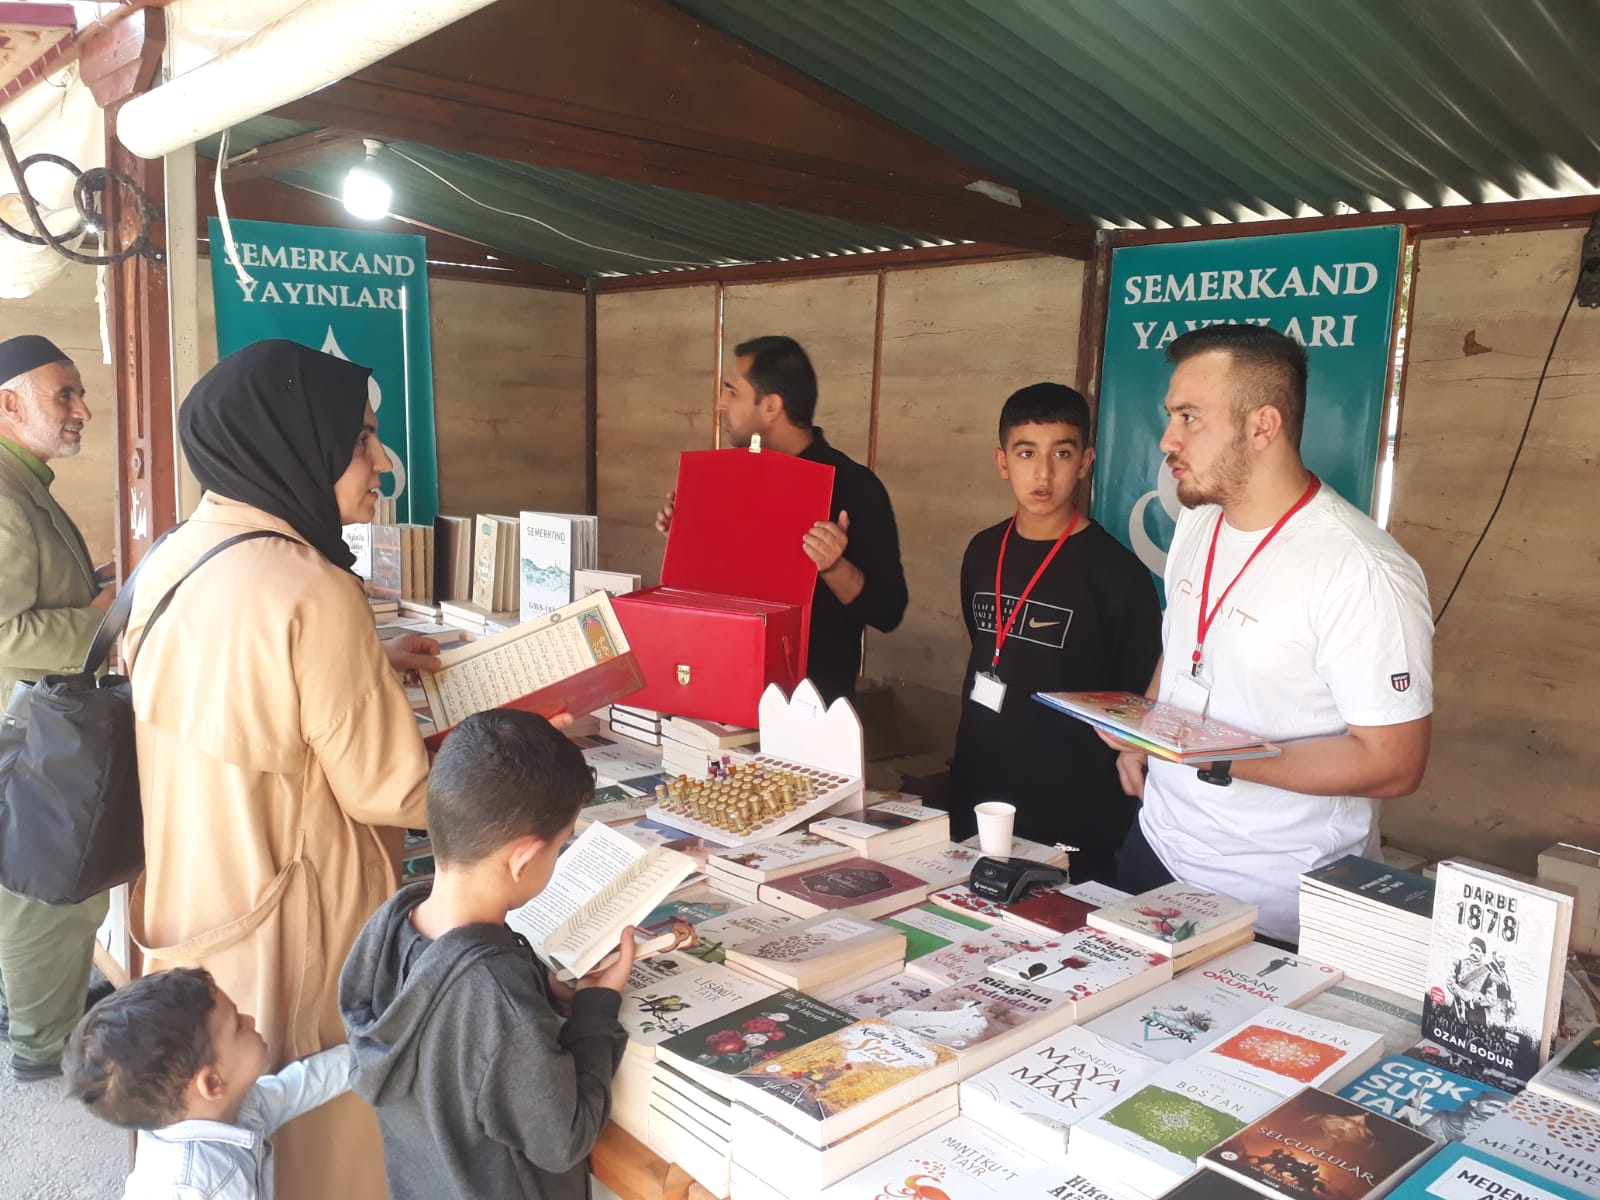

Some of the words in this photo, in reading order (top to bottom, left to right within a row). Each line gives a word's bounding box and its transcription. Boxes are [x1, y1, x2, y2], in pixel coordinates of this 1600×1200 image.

[224, 242, 415, 277] SEMERKAND
[1124, 262, 1379, 305] SEMERKAND
[1132, 315, 1359, 350] YAARI
[1463, 883, 1518, 913] DARBE
[1456, 901, 1518, 942] 1878
[1073, 945, 1116, 963] Başlar
[1078, 939, 1130, 962] Sondan
[963, 983, 1041, 1013] Ardından
[978, 976, 1053, 1005] Rüzgârın
[1202, 971, 1279, 1002] OKUMAK
[1139, 1015, 1197, 1043] TUTSAK
[1433, 1028, 1466, 1049] OZAN
[1469, 1043, 1514, 1069] BODUR
[1036, 1046, 1121, 1092] MAYA
[1042, 1065, 1082, 1092] LA
[1381, 1062, 1473, 1102] GÖK
[1008, 1066, 1092, 1109] MAK
[1175, 1080, 1244, 1113] BOSTAN
[1350, 1086, 1434, 1127] TAN
[951, 1154, 986, 1177] TAYR
[1257, 1126, 1376, 1187] SELÇUKLULAR
[1063, 1174, 1115, 1200] Hike
[1457, 1169, 1540, 1200] MEDEN
